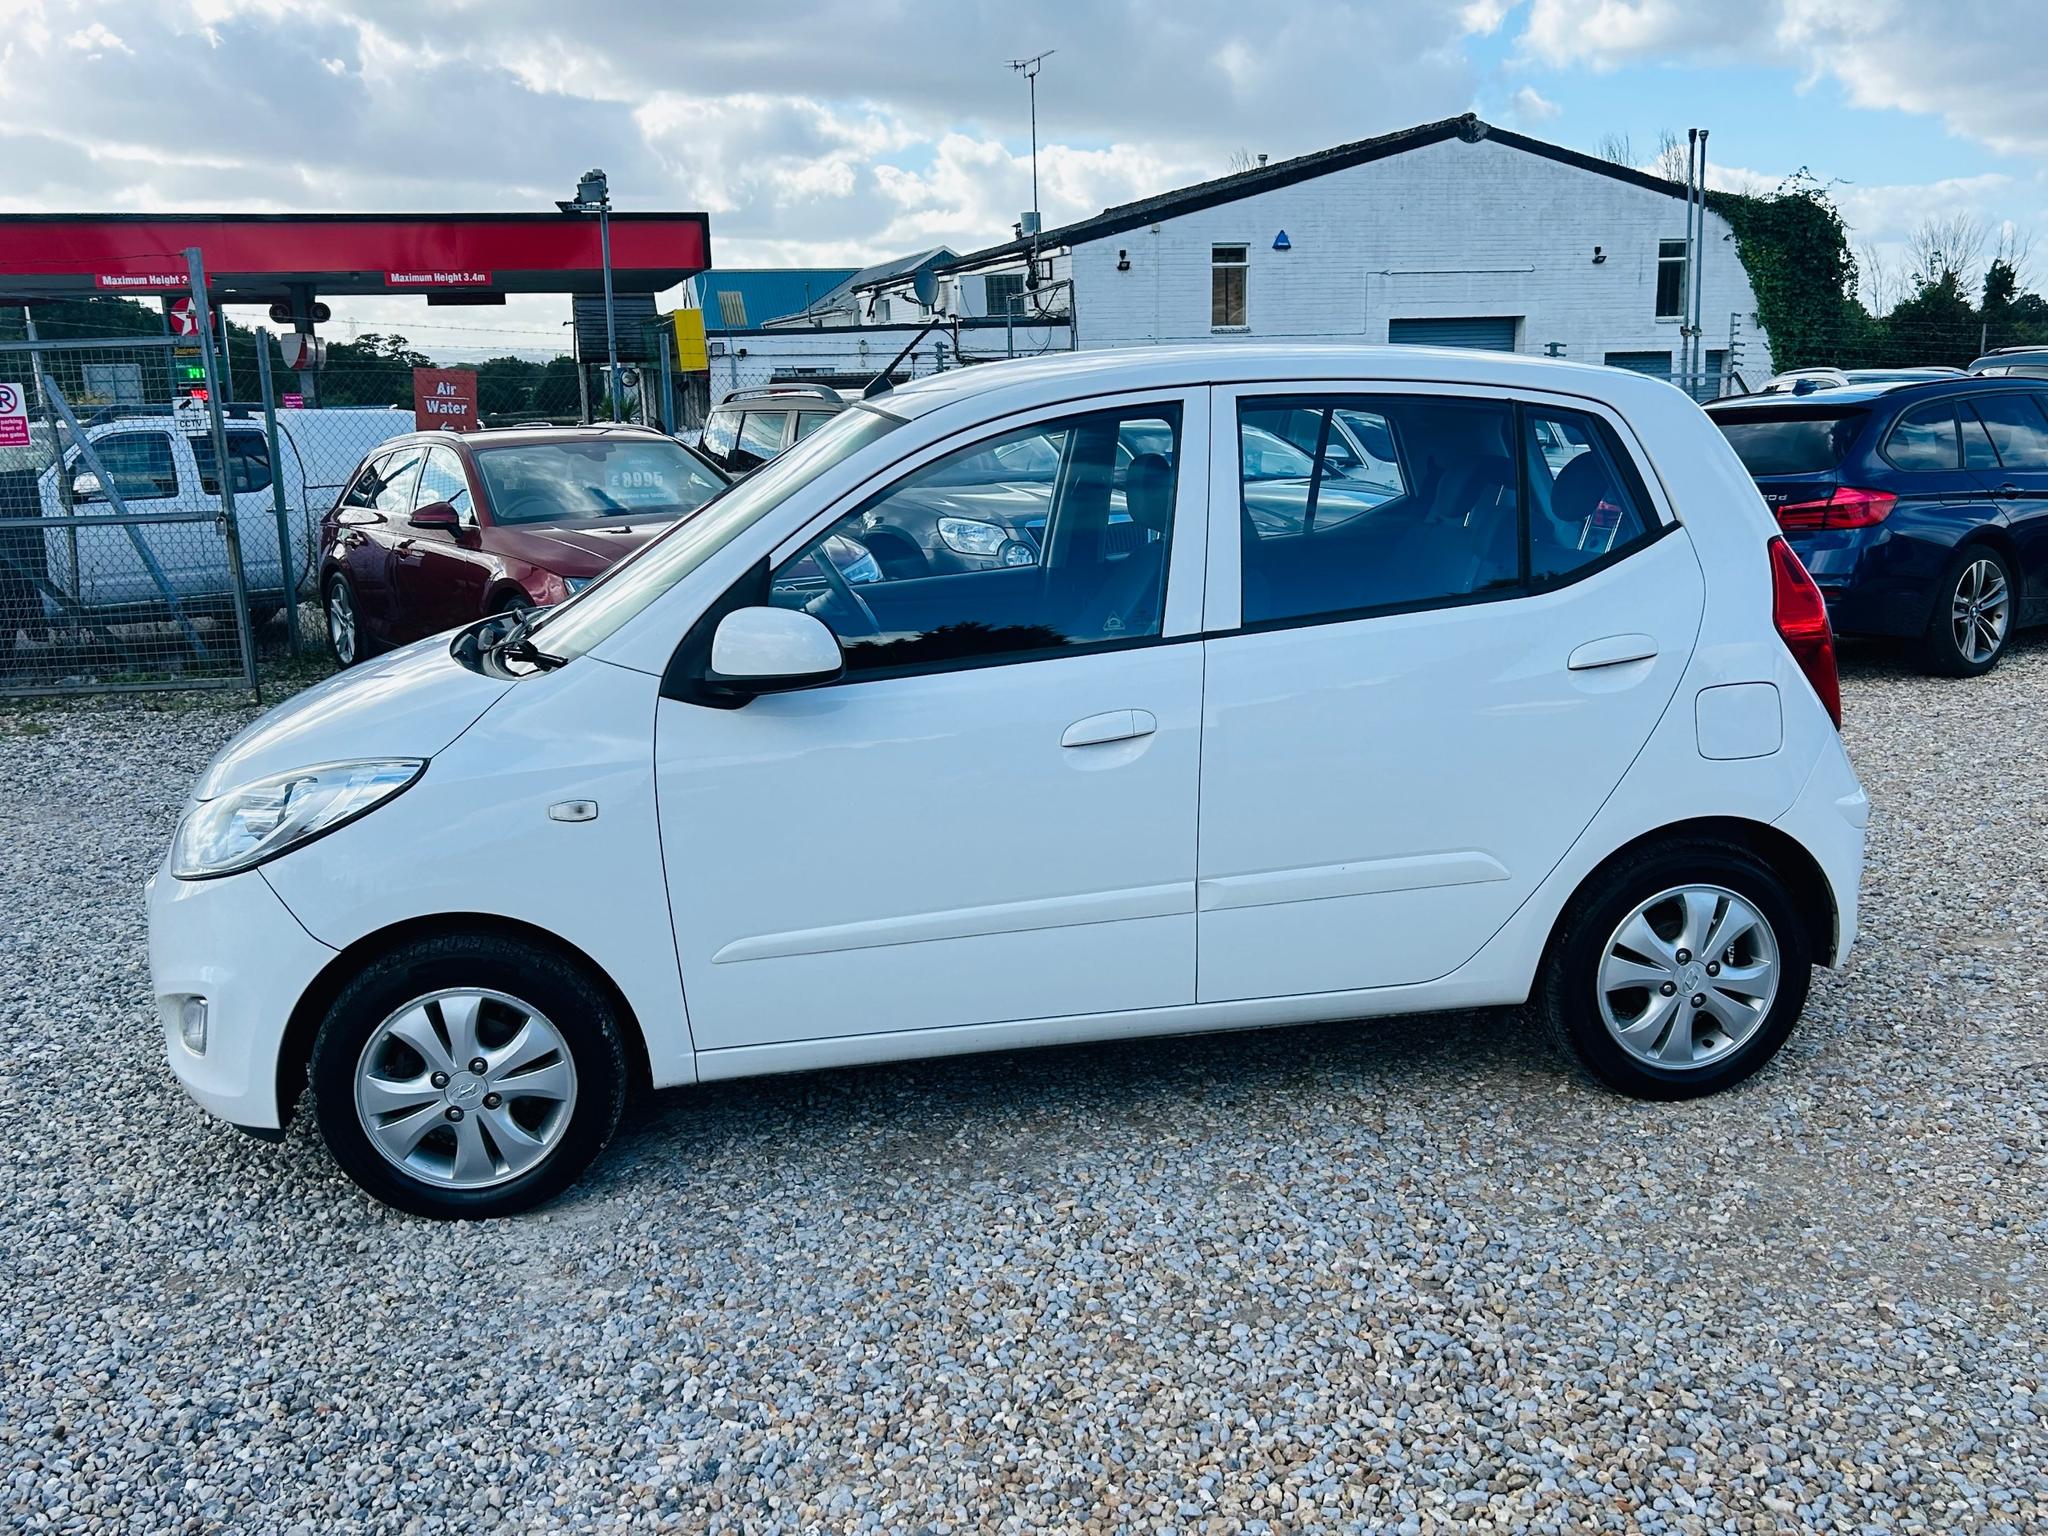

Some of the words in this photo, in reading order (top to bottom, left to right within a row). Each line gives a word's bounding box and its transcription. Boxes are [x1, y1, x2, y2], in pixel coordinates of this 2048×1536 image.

[102, 275, 148, 285] Maximum
[149, 275, 179, 286] Height
[391, 273, 433, 282] Maximum
[434, 272, 462, 283] Height
[463, 272, 486, 282] 3.4m
[436, 381, 457, 396] Air
[425, 400, 468, 415] Water
[179, 419, 202, 428] CCTV
